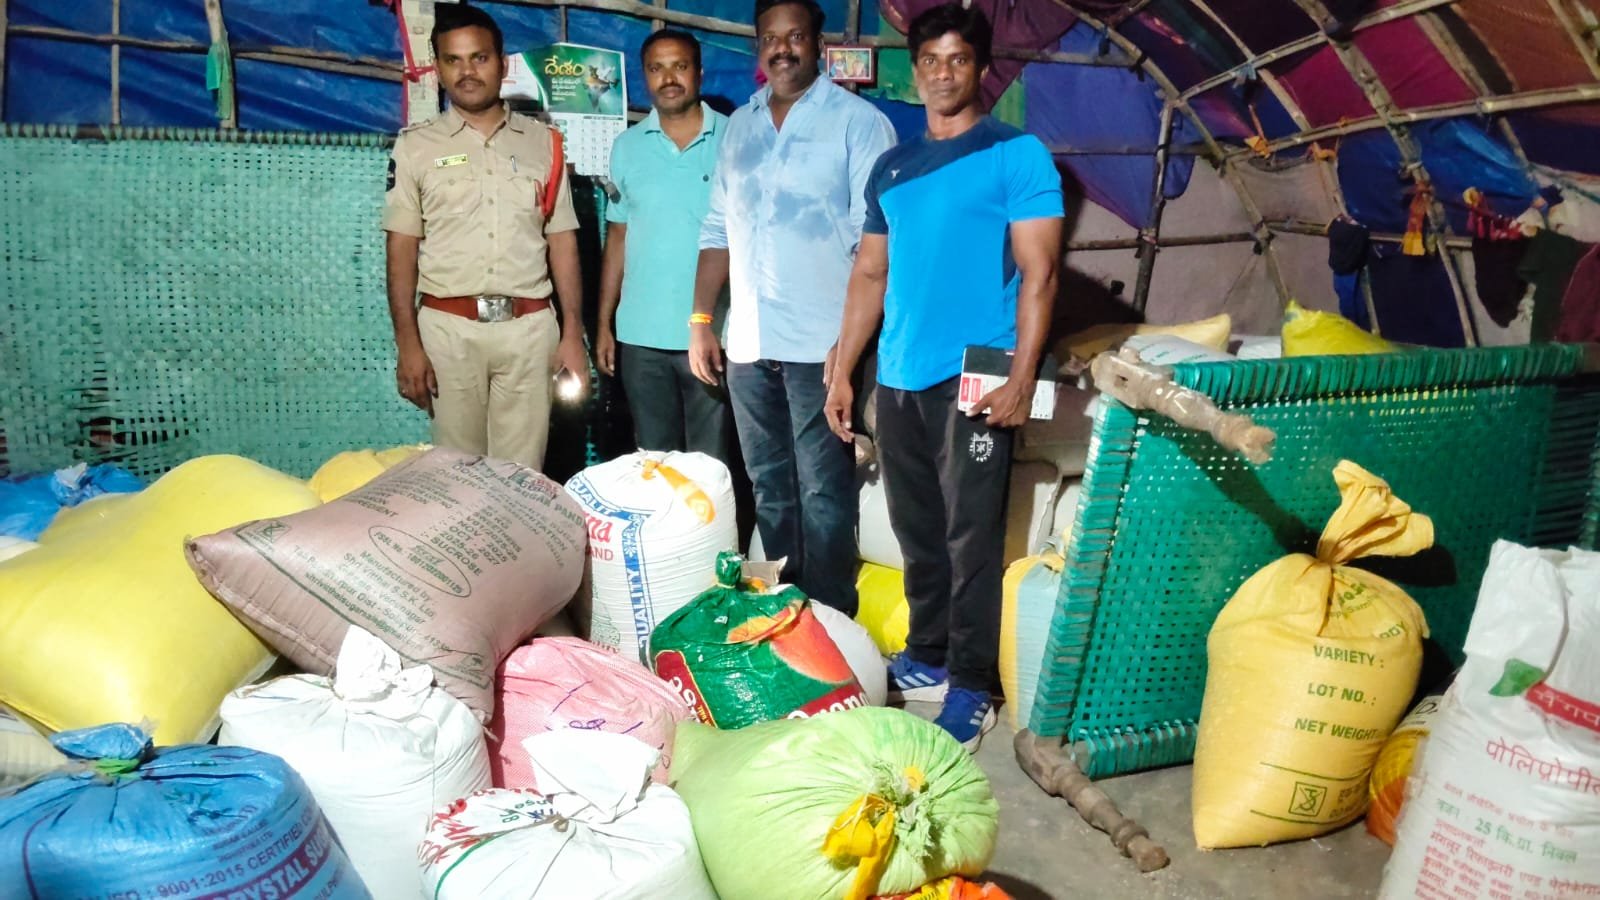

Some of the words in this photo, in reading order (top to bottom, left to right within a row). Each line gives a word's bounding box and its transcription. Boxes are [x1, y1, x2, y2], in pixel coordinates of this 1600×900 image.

[448, 523, 473, 543] OCT
[457, 518, 482, 539] NOV
[485, 540, 508, 562] 2025
[431, 537, 481, 575] SUCROSE
[1314, 644, 1375, 666] VARIETY
[1308, 682, 1337, 698] LOT
[1341, 688, 1367, 704] NO.
[1295, 718, 1327, 735] NET
[1331, 724, 1377, 740] WEIGHT
[1473, 817, 1493, 835] 25
[156, 864, 245, 897] 9001:2015
[213, 859, 309, 900] RYSTAL
